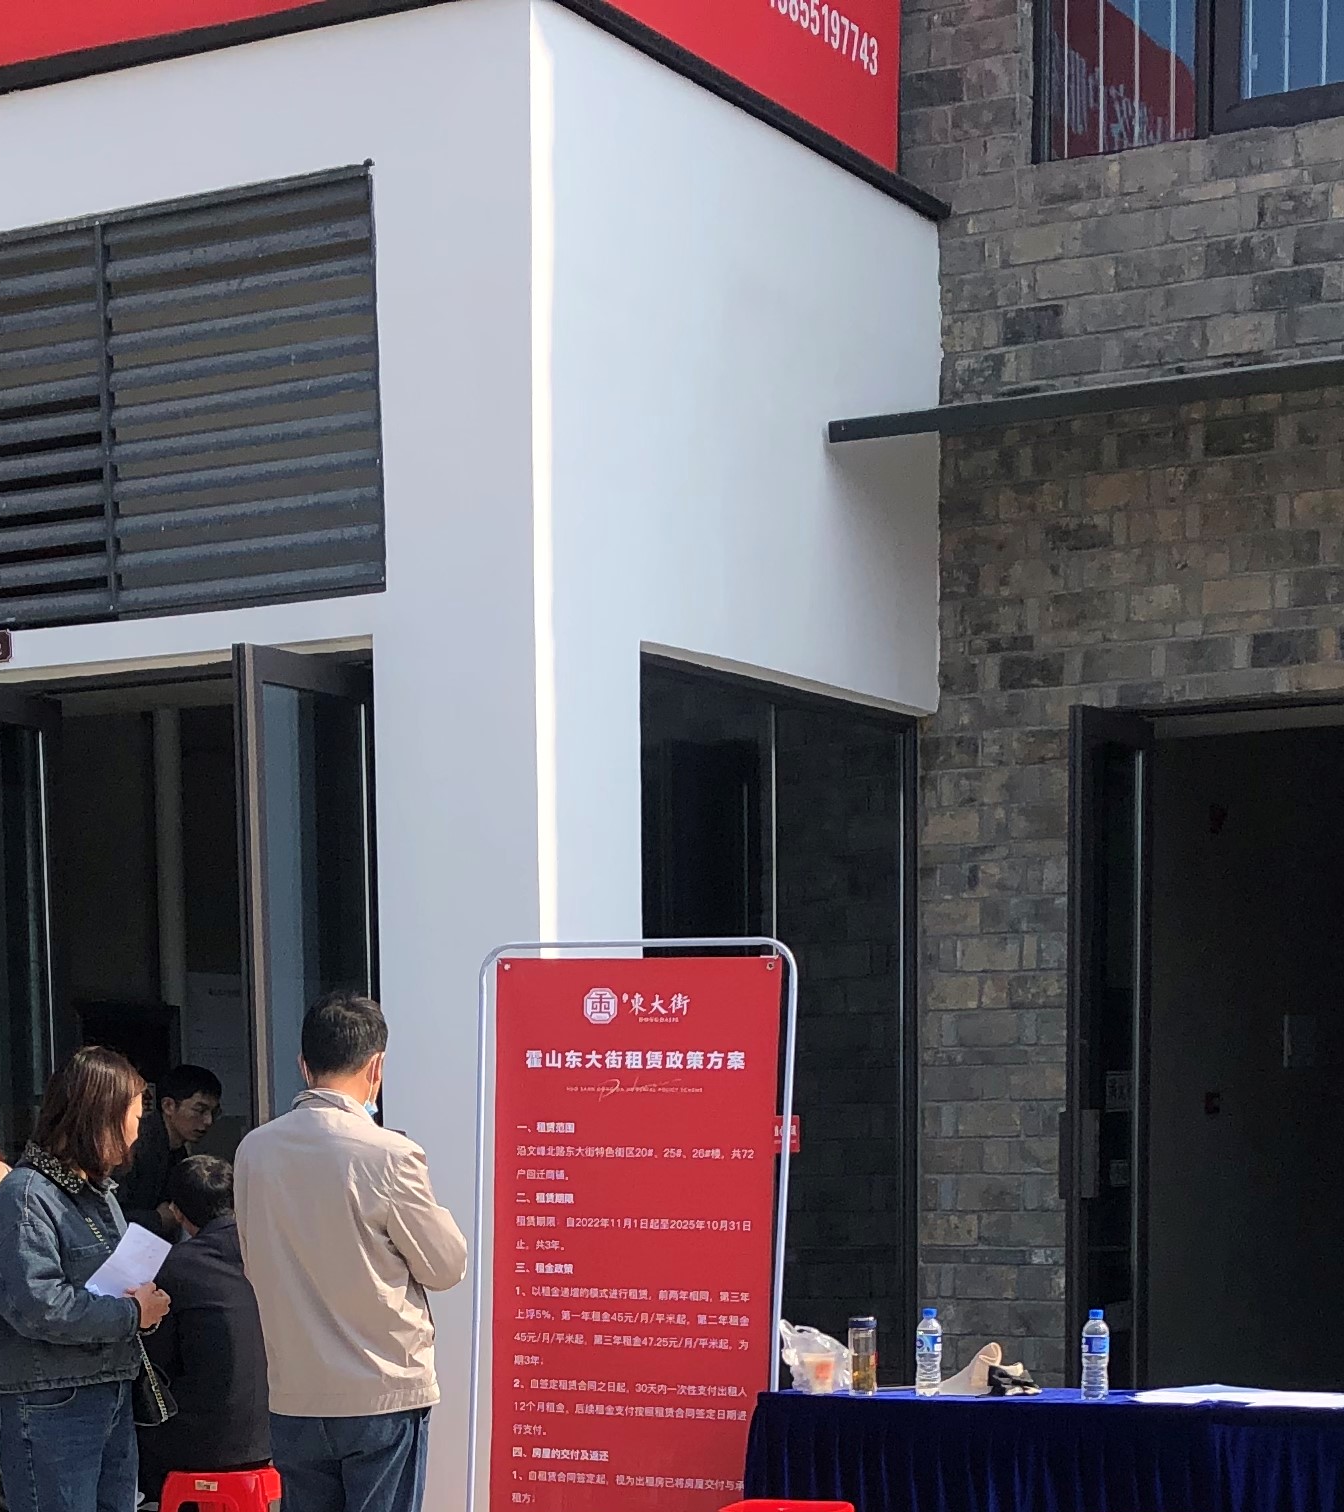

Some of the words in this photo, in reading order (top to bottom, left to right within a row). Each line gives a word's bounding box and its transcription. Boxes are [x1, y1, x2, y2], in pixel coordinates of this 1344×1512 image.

[771, 0, 878, 75] 855197743
[629, 993, 691, 1016] 東大街
[525, 1051, 746, 1070] 霍山东大街租赁政策方案
